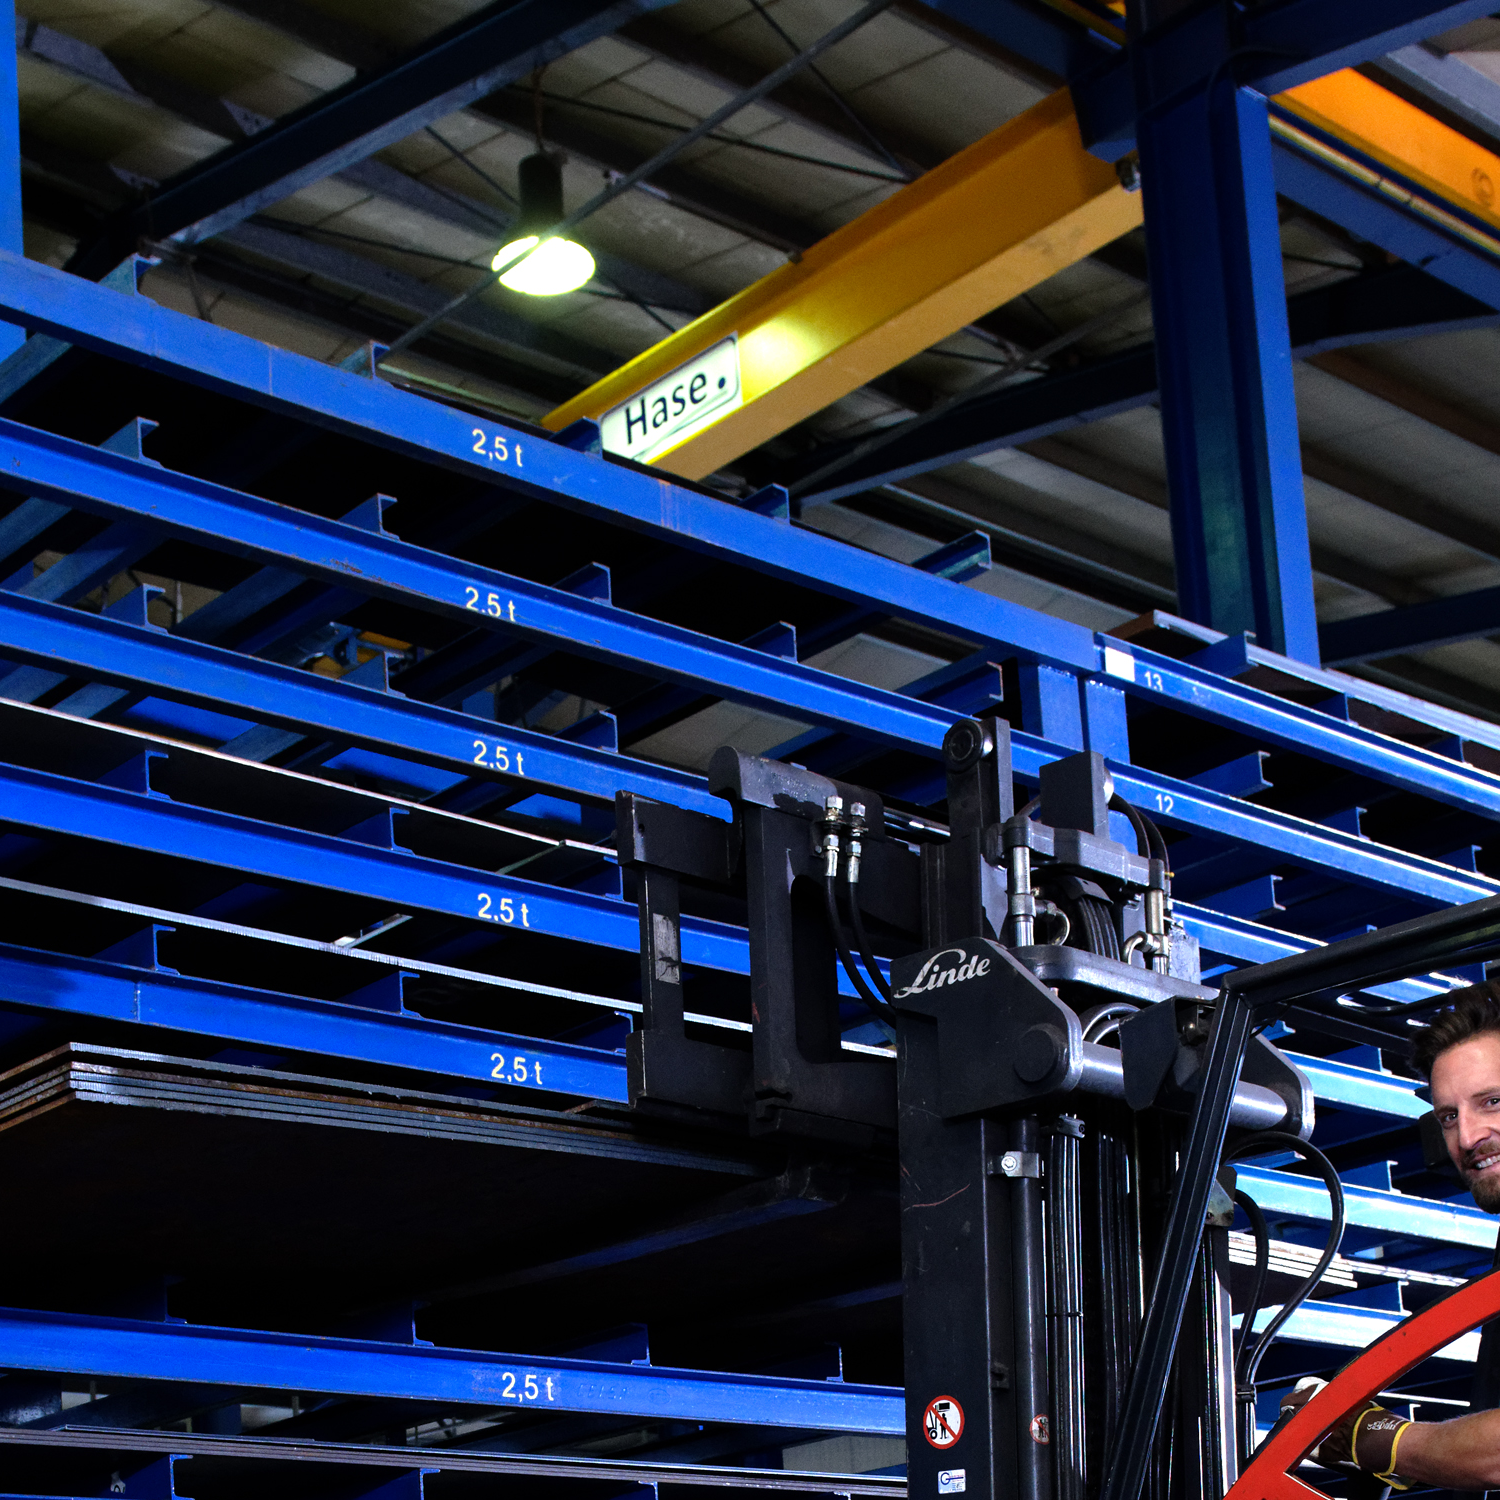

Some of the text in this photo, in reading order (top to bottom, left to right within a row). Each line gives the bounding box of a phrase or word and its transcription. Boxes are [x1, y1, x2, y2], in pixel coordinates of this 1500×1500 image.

[515, 444, 523, 467] t
[508, 600, 516, 622] t
[1144, 671, 1163, 692] 13
[517, 753, 525, 776] t
[1156, 793, 1175, 814] 12
[521, 903, 530, 928] t
[894, 947, 991, 999] Linde
[534, 1061, 543, 1085] t
[502, 1371, 539, 1403] 2,5
[546, 1376, 555, 1402] t
